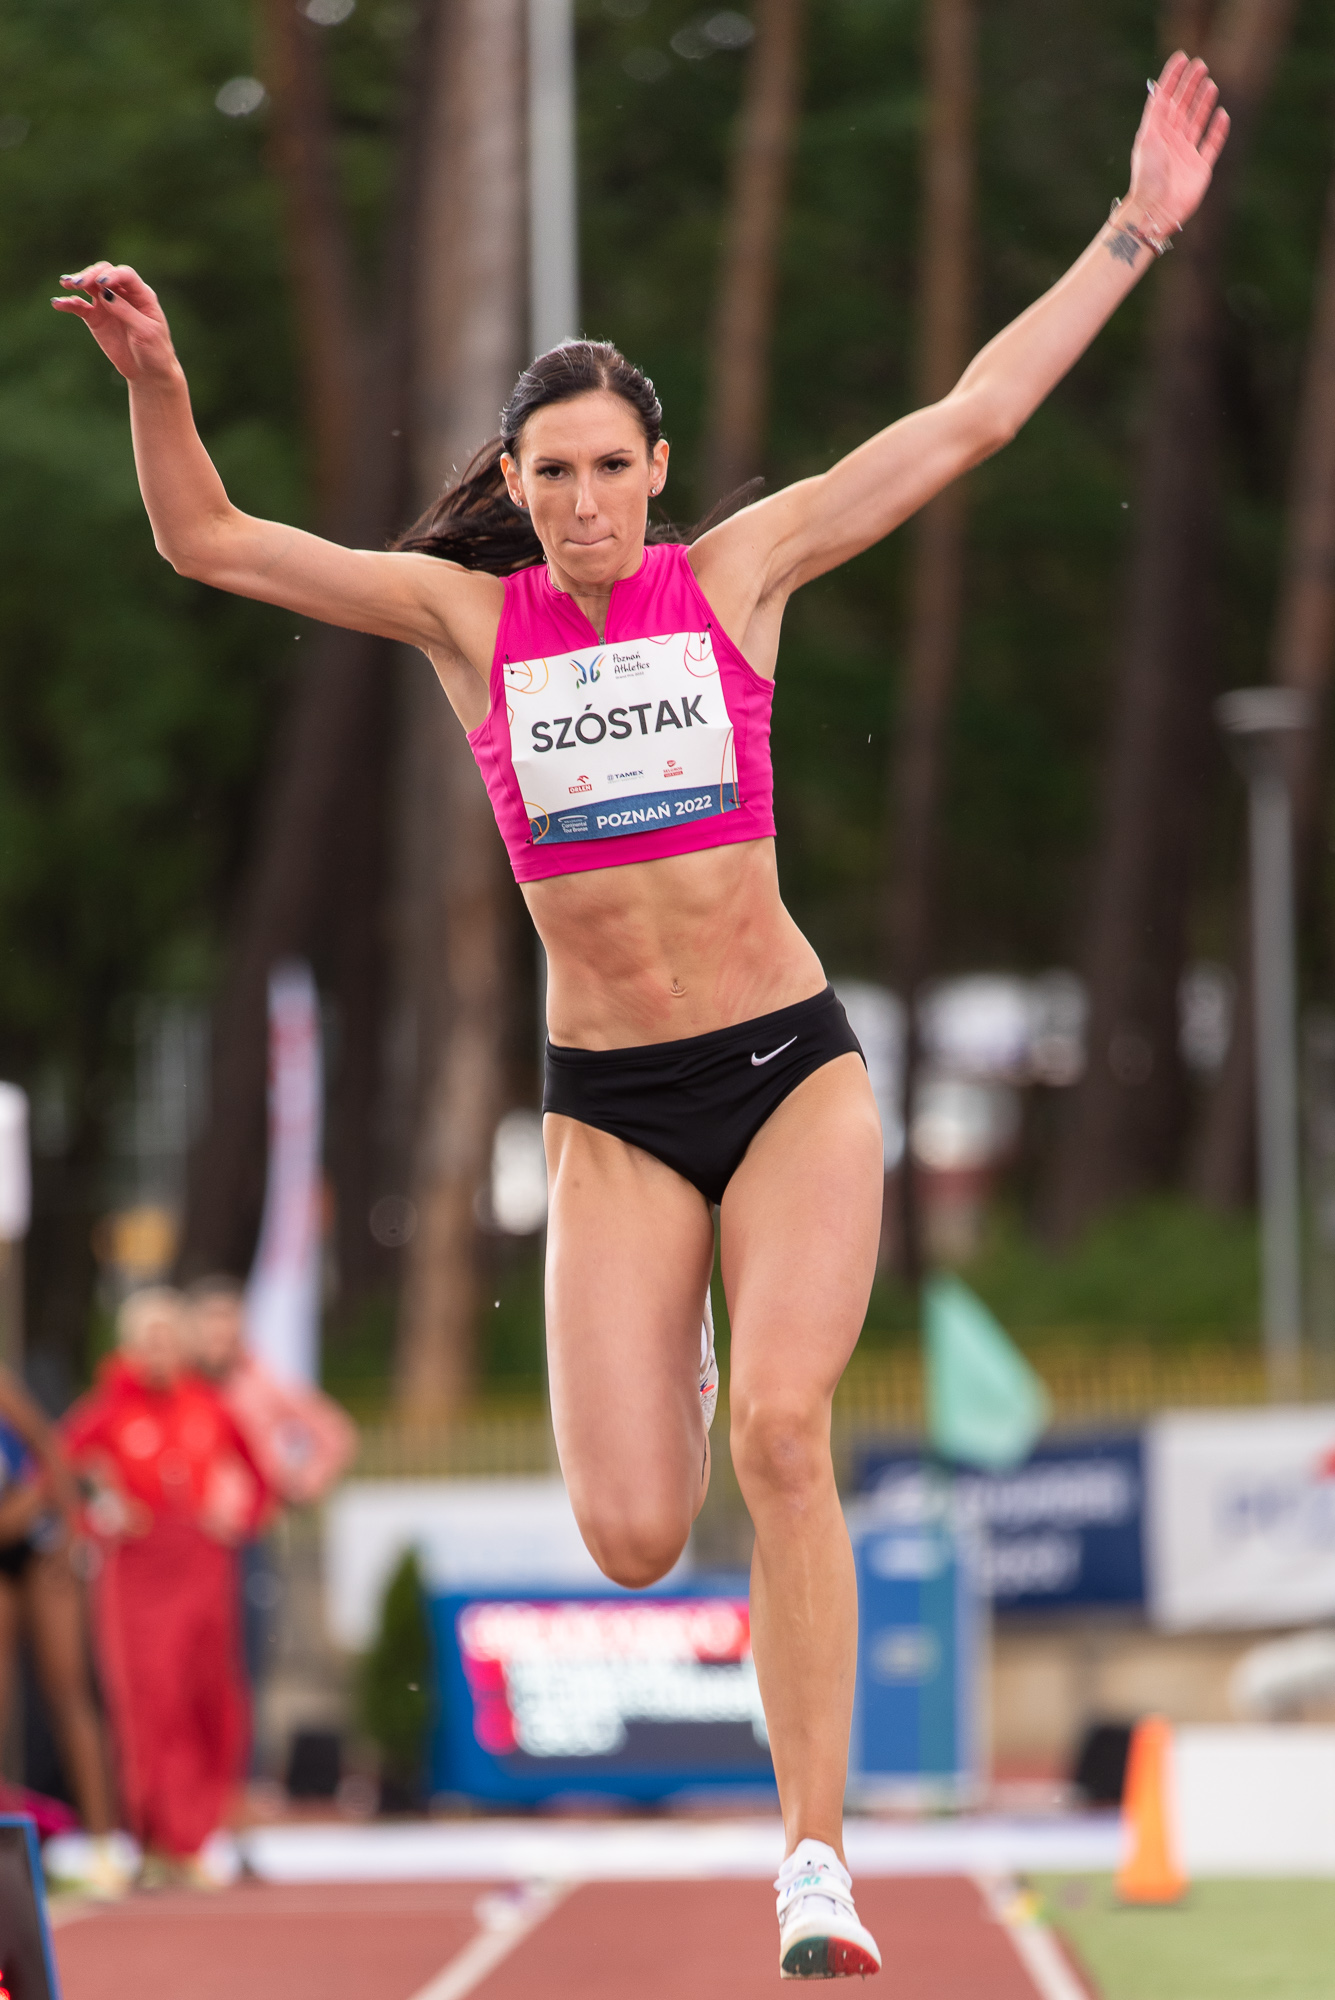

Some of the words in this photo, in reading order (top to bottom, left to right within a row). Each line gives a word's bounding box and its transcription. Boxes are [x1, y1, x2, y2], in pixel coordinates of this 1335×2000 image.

[612, 651, 641, 663] Poznań
[614, 662, 650, 674] Athletics
[531, 694, 708, 753] SZÓSTAK
[615, 770, 644, 779] TAMEX
[569, 784, 591, 794] ORLEN
[596, 801, 671, 830] POZNAŃ
[674, 794, 713, 816] 2022
